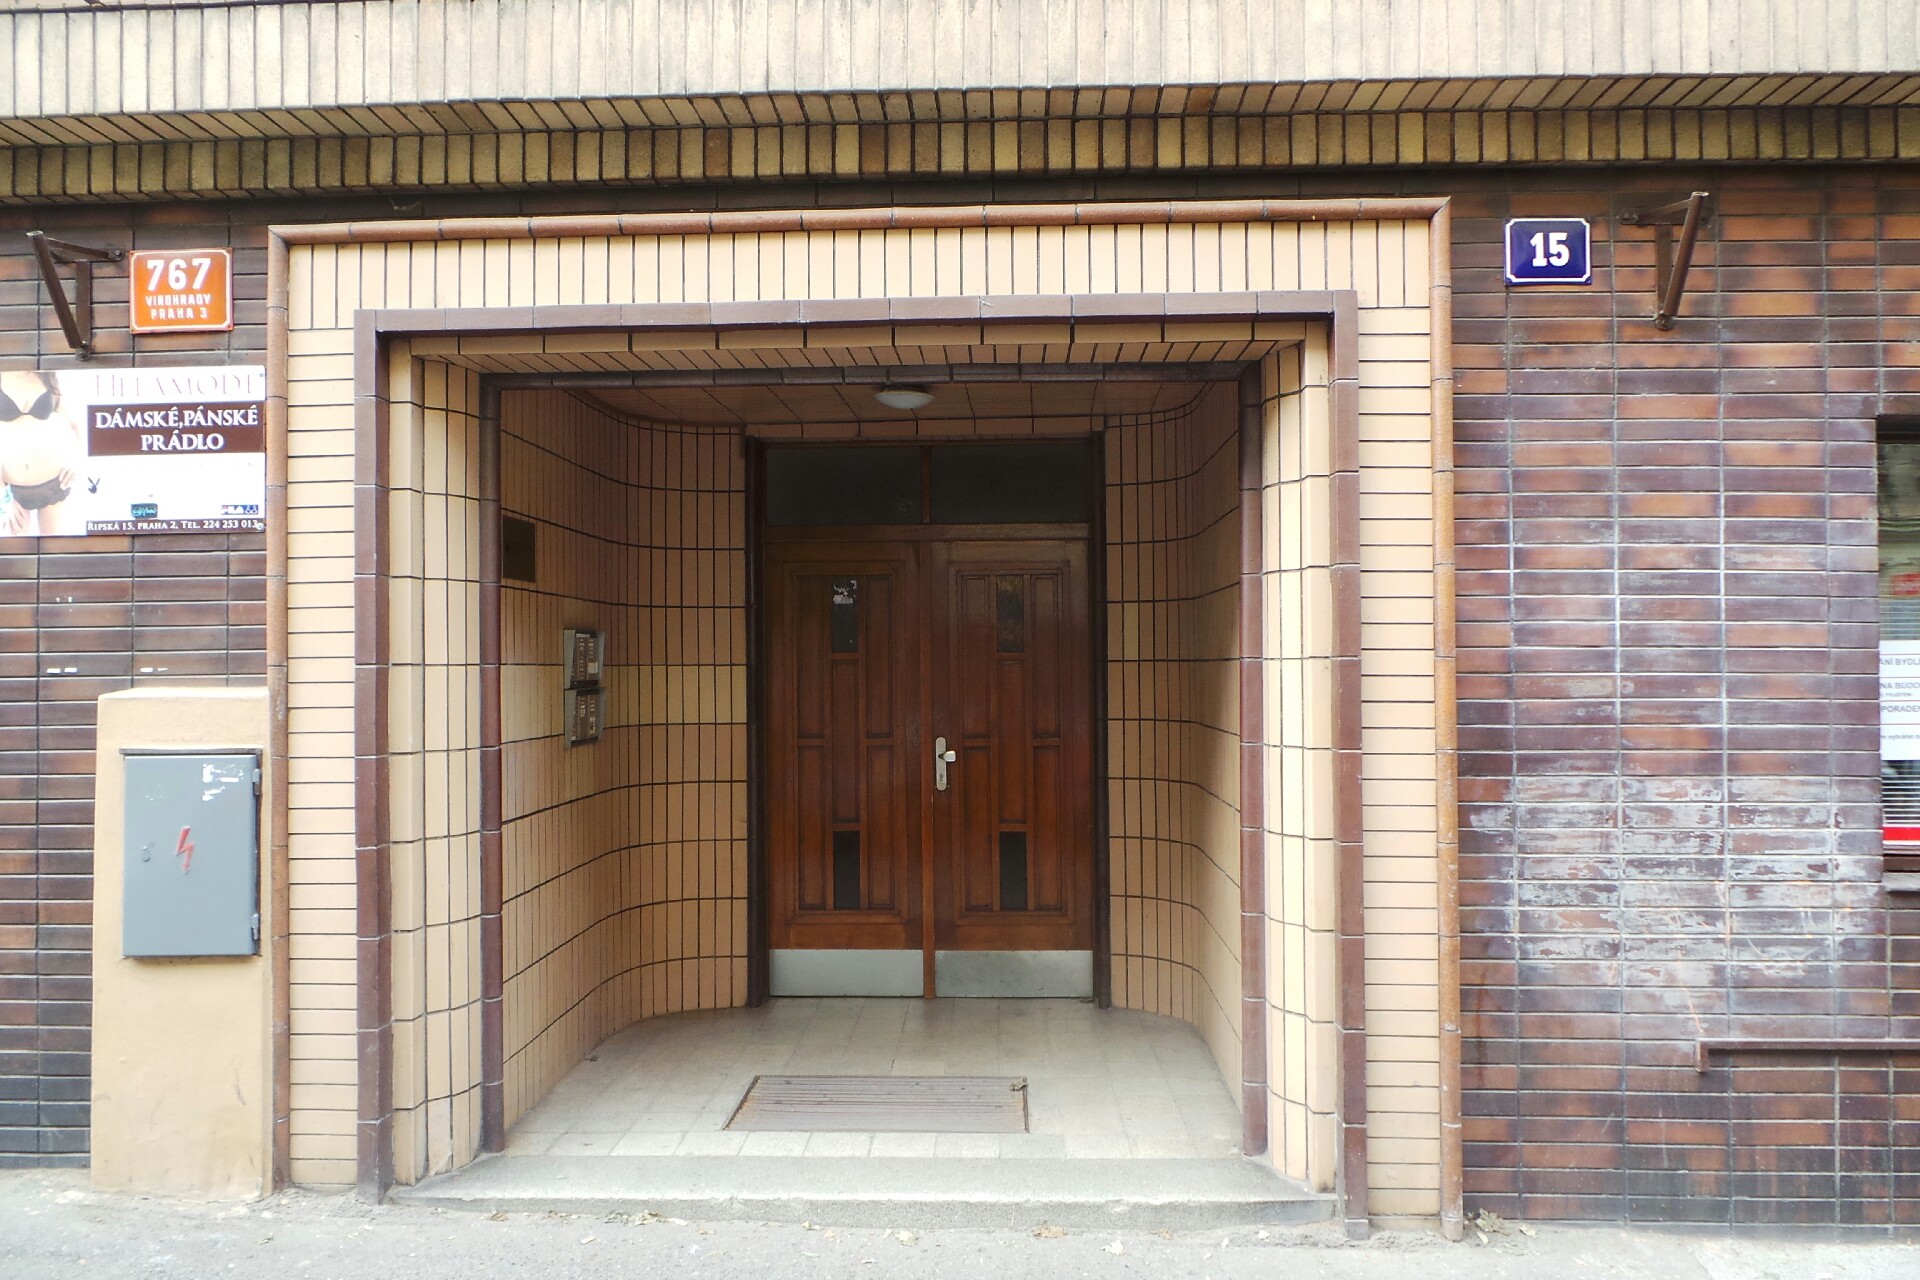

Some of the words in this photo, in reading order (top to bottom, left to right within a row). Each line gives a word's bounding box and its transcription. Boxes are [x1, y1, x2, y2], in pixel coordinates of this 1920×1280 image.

[1530, 232, 1570, 267] 15
[147, 258, 211, 291] 767
[146, 294, 211, 306] VINOHRADY
[150, 308, 194, 320] PRAHA
[199, 307, 208, 319] 3
[141, 429, 224, 451] PRÁDLO
[137, 522, 168, 530] PRAHA
[203, 520, 220, 529] 224
[222, 520, 239, 528] 253
[241, 519, 258, 528] 013
